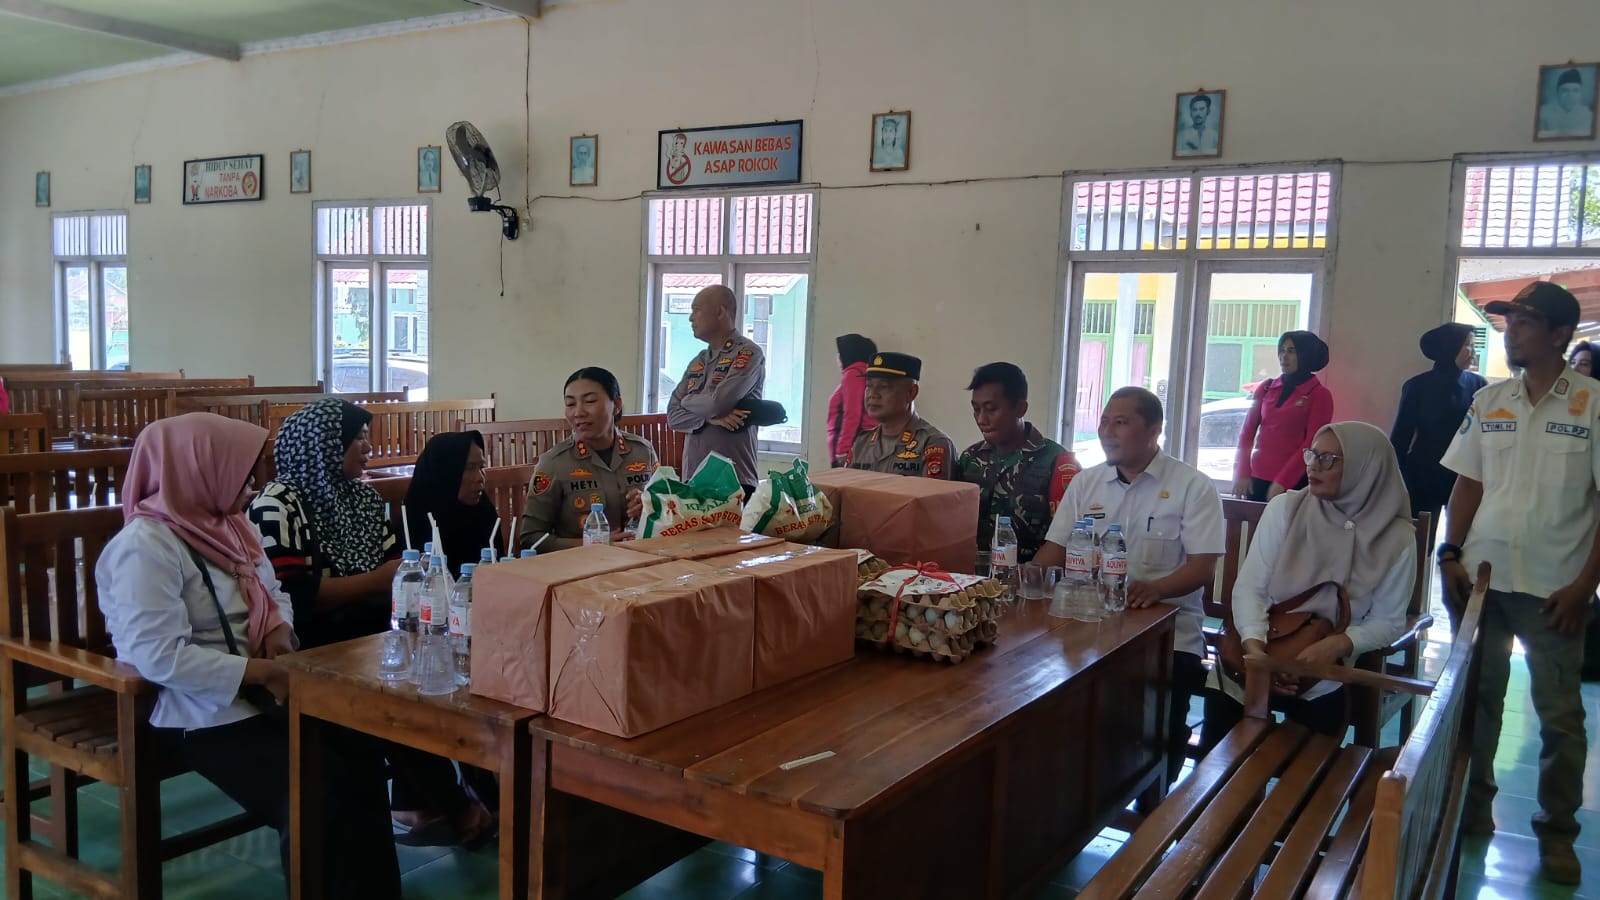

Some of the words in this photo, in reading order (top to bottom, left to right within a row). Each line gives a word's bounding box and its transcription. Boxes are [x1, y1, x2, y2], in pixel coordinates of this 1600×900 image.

[694, 139, 752, 155] KAWASAN
[756, 135, 792, 152] BEBAS
[205, 161, 228, 172] HIDUP
[229, 159, 254, 169] SEHAT
[704, 159, 736, 174] ASAP
[738, 157, 778, 172] ROKOK
[219, 172, 240, 181] TANPA
[205, 185, 238, 199] NARKOBA
[894, 462, 920, 471] POLRI
[570, 480, 598, 491] HETI
[660, 517, 698, 537] BERAS
